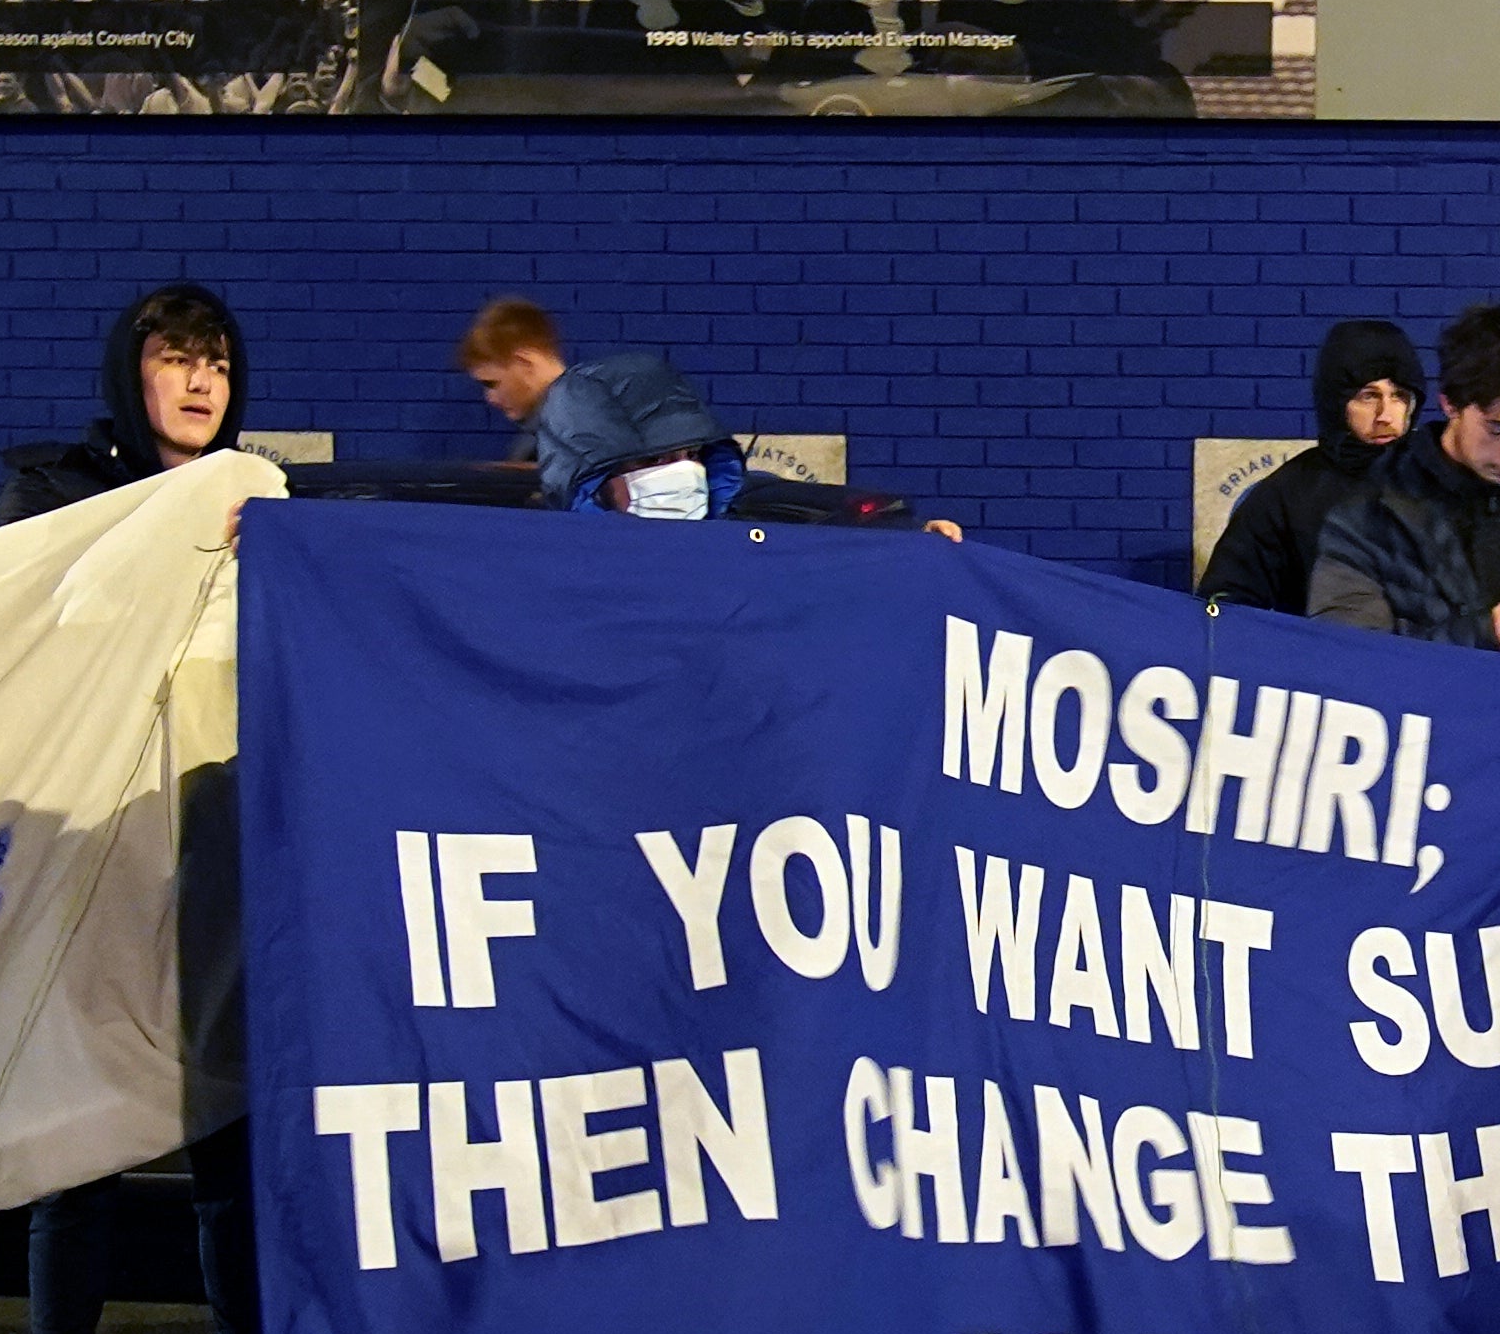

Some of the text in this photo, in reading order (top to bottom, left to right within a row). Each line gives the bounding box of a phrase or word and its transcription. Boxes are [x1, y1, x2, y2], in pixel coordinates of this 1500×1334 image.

[41, 31, 93, 49] against
[96, 31, 163, 50] Coventry
[164, 30, 196, 49] City
[645, 31, 1017, 50] 1998 Walter Smith is appointed Everton Manager
[753, 447, 818, 484] ATSON
[1219, 453, 1274, 496] BRIAN
[942, 614, 1453, 894] MOSHIRI;
[395, 829, 538, 1008] IF
[635, 812, 901, 992] YOU
[954, 844, 1275, 1060] WANT
[312, 1047, 778, 1271] THEN
[843, 1055, 1297, 1265] CHANGE
